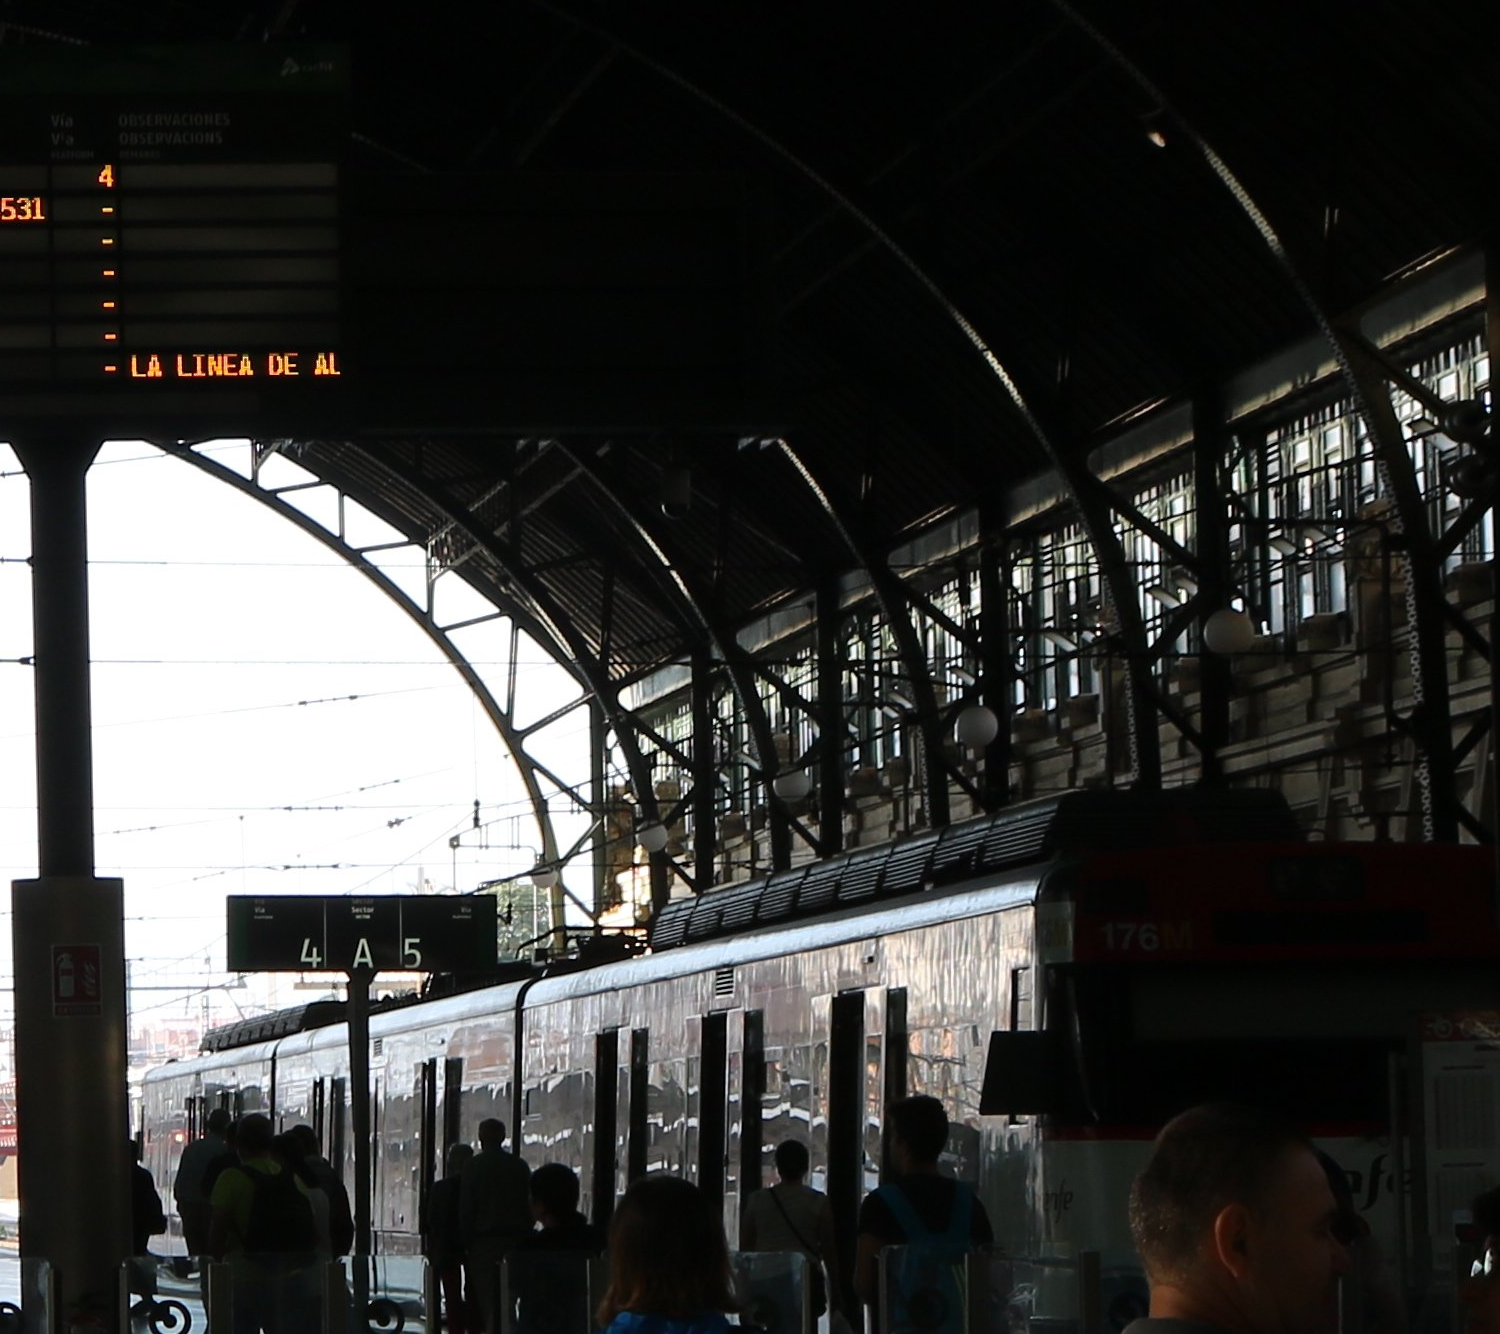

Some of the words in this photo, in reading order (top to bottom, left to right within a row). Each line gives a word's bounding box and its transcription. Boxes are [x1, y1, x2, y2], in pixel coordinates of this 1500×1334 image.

[119, 113, 231, 127] OBSERVACIONES
[119, 131, 223, 145] OBSERVACIONS
[98, 164, 115, 188] 4
[130, 354, 164, 379] LA
[175, 353, 255, 378] LINEA
[267, 352, 300, 376] DE
[313, 352, 341, 376] AL
[1100, 922, 1193, 951] 176M
[300, 938, 322, 969] 4
[352, 938, 374, 969] A
[404, 938, 422, 969] 5
